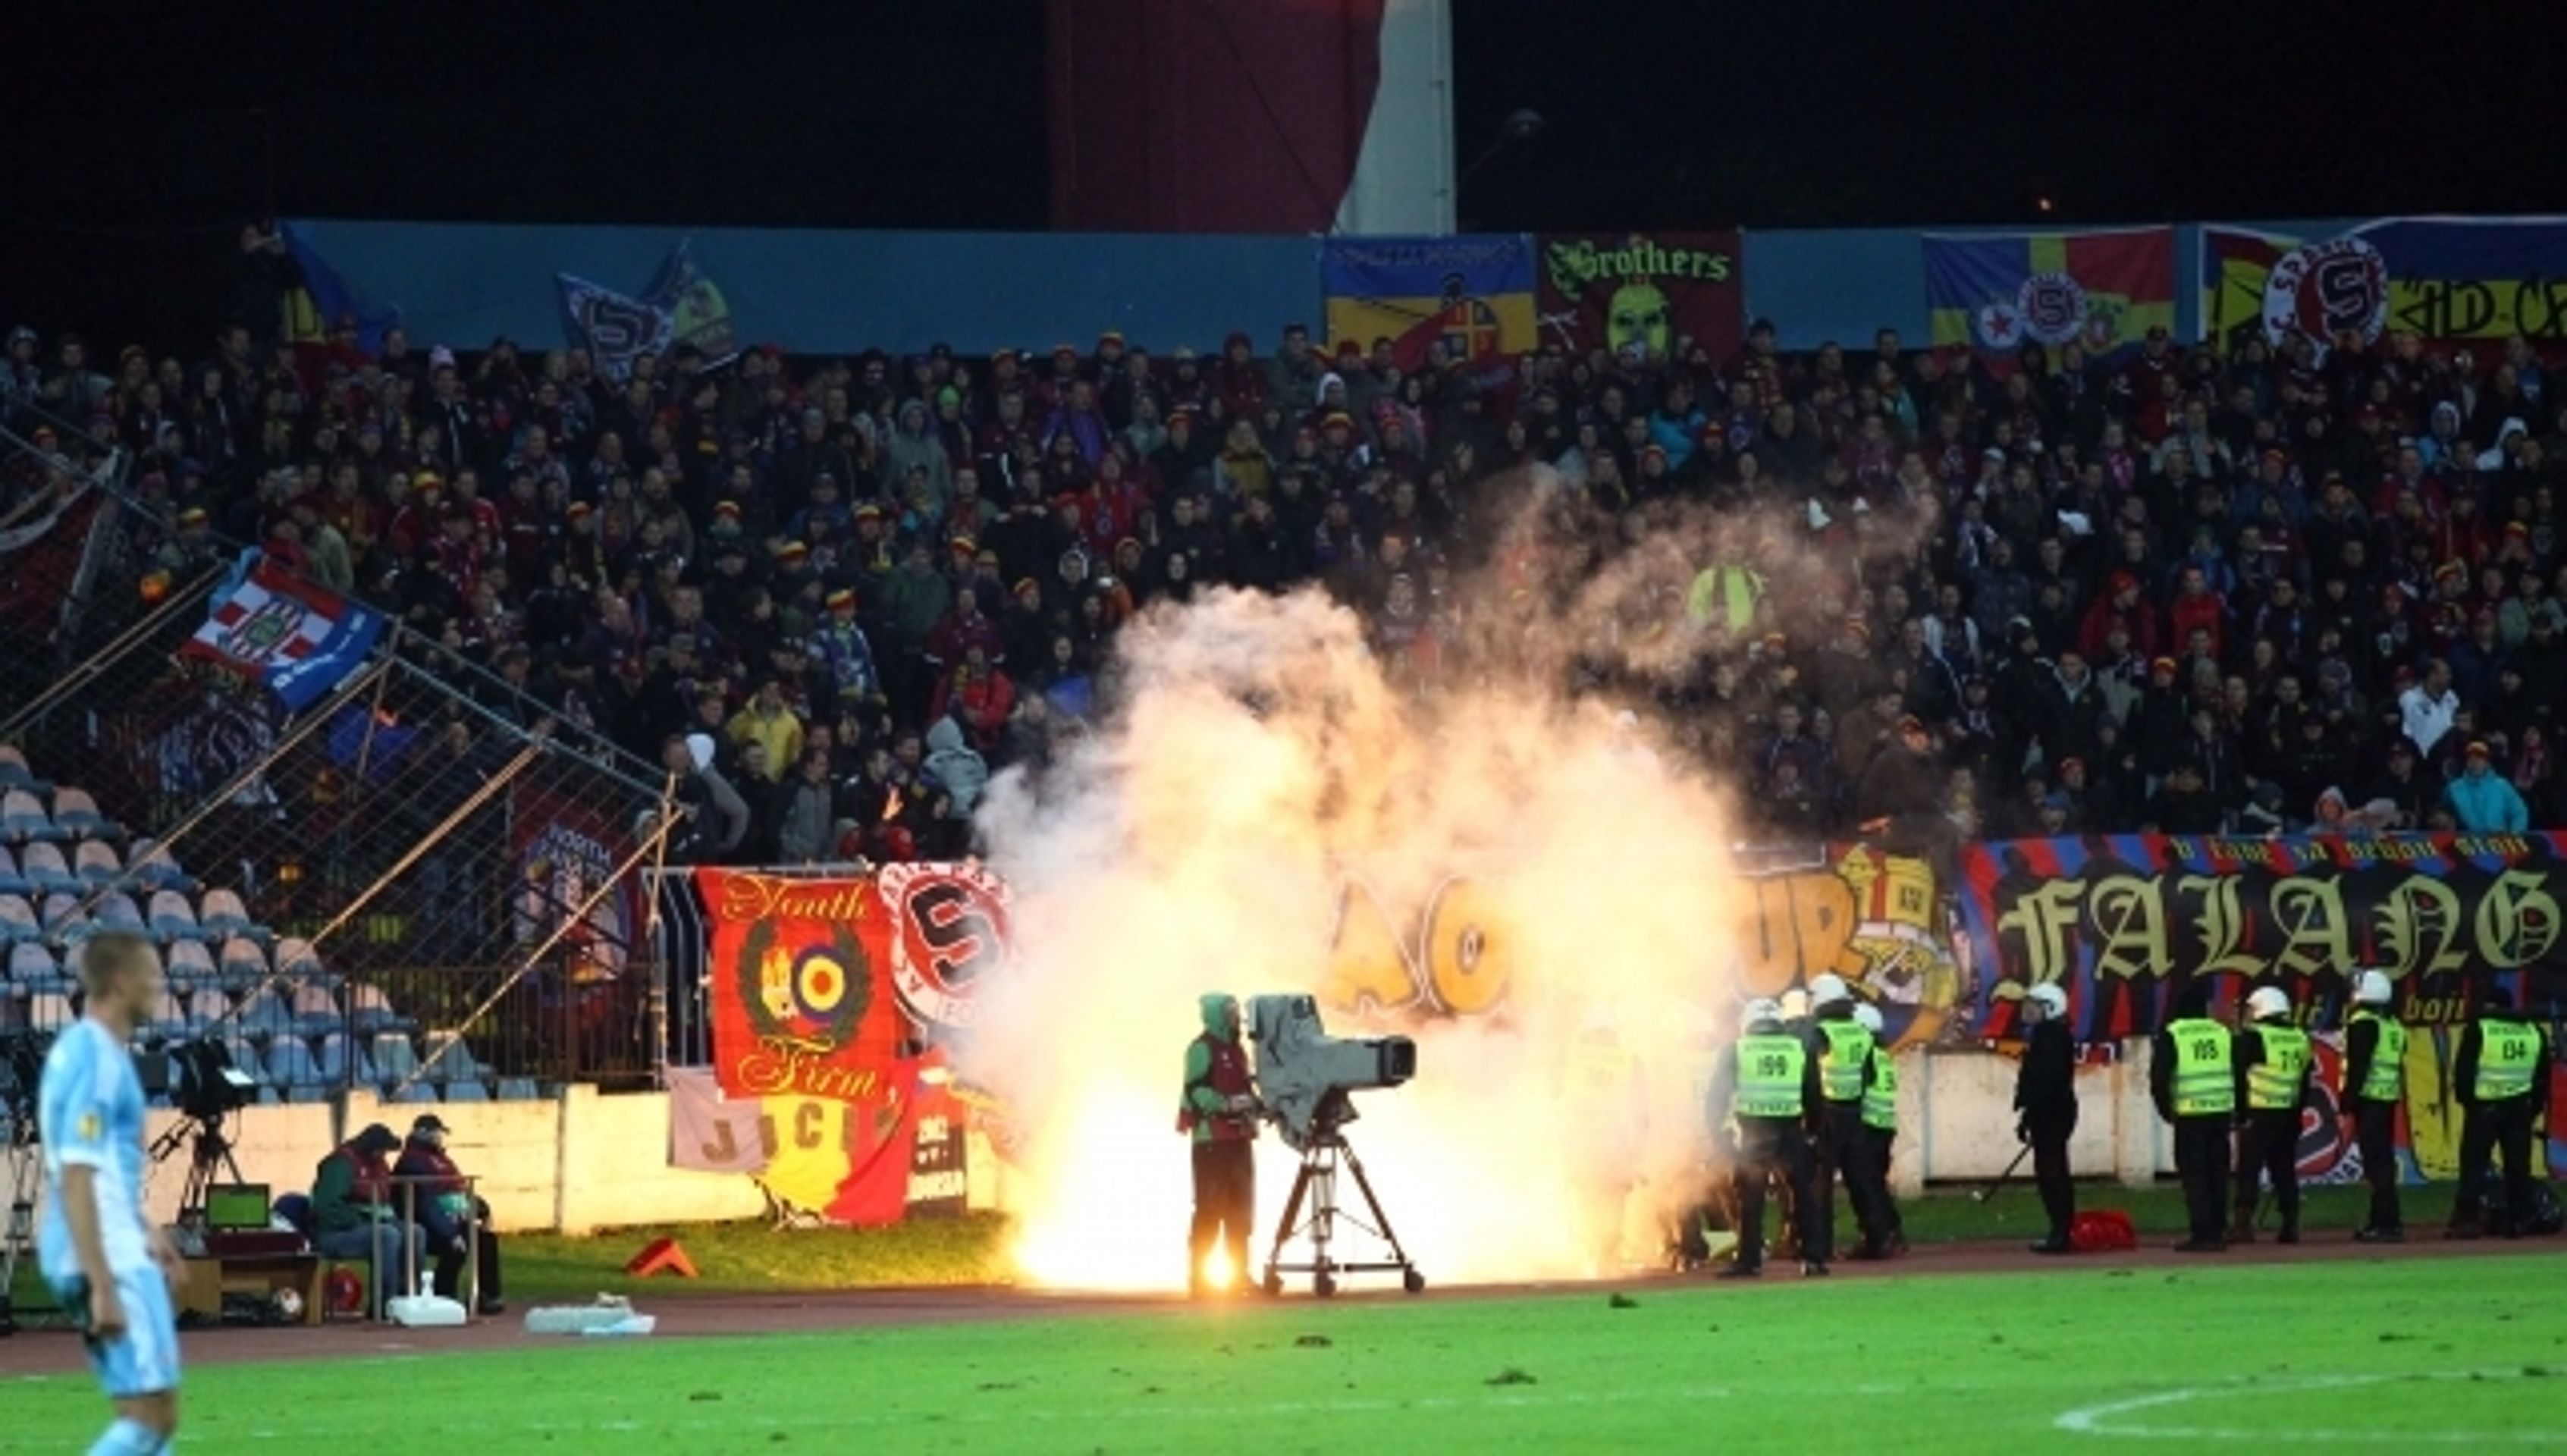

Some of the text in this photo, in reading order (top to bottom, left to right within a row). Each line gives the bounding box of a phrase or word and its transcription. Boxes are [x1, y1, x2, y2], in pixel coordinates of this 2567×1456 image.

[1546, 239, 1731, 302] Brothers
[722, 873, 866, 921] Youth
[737, 1034, 876, 1093] Firm
